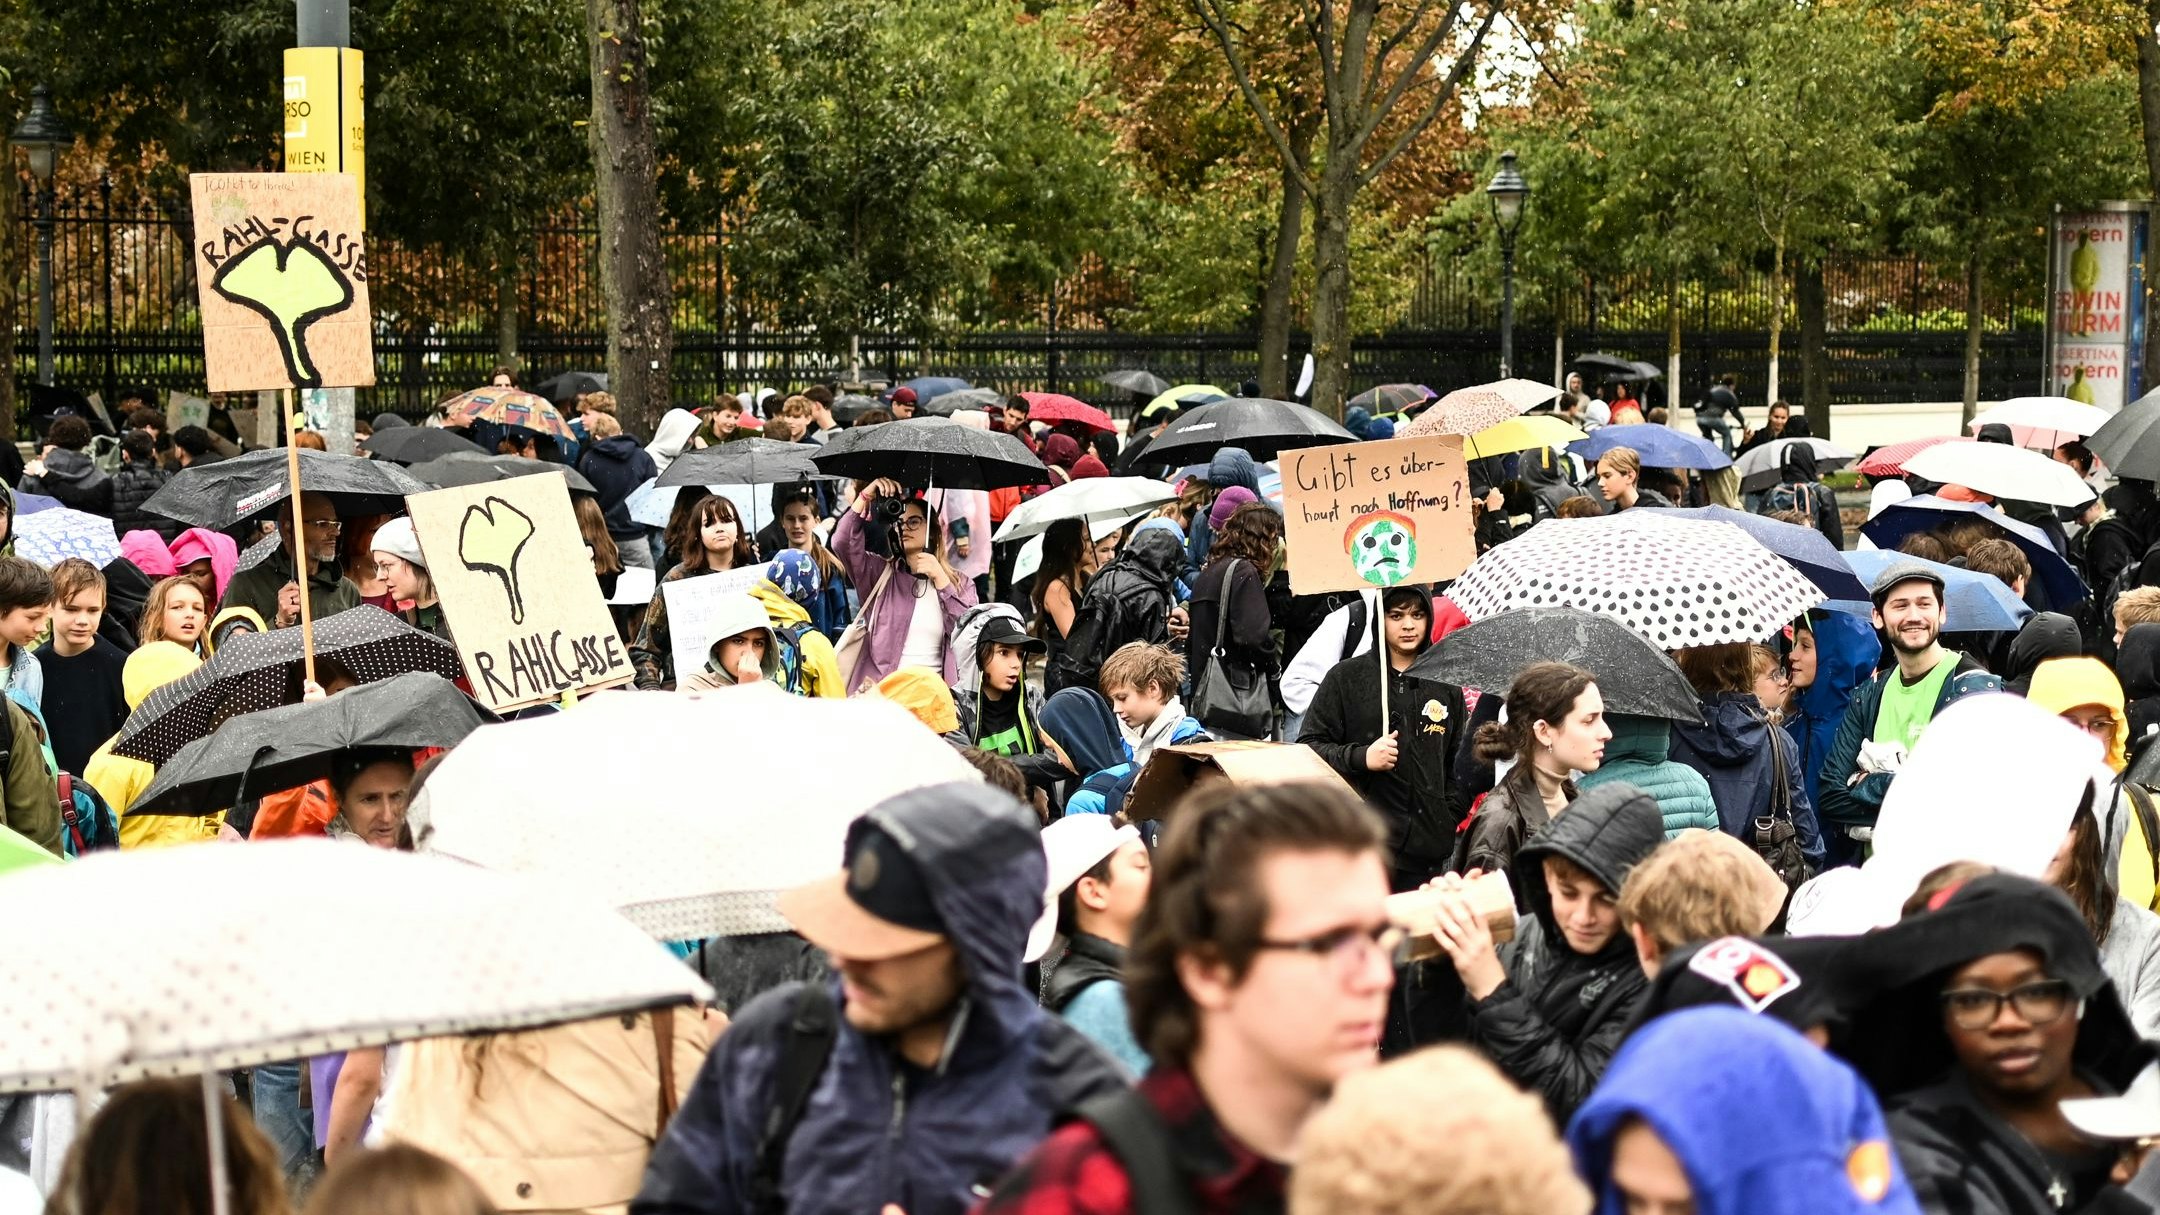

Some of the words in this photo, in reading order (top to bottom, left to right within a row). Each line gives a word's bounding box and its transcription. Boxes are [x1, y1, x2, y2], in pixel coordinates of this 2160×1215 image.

[287, 151, 325, 165] WIEN
[1296, 453, 1357, 492] Gibt
[1371, 465, 1391, 482] es
[1400, 452, 1445, 475] über-
[1302, 498, 1340, 523] haupt
[1350, 497, 1380, 514] noch
[475, 629, 624, 705] RAHLGASSE
